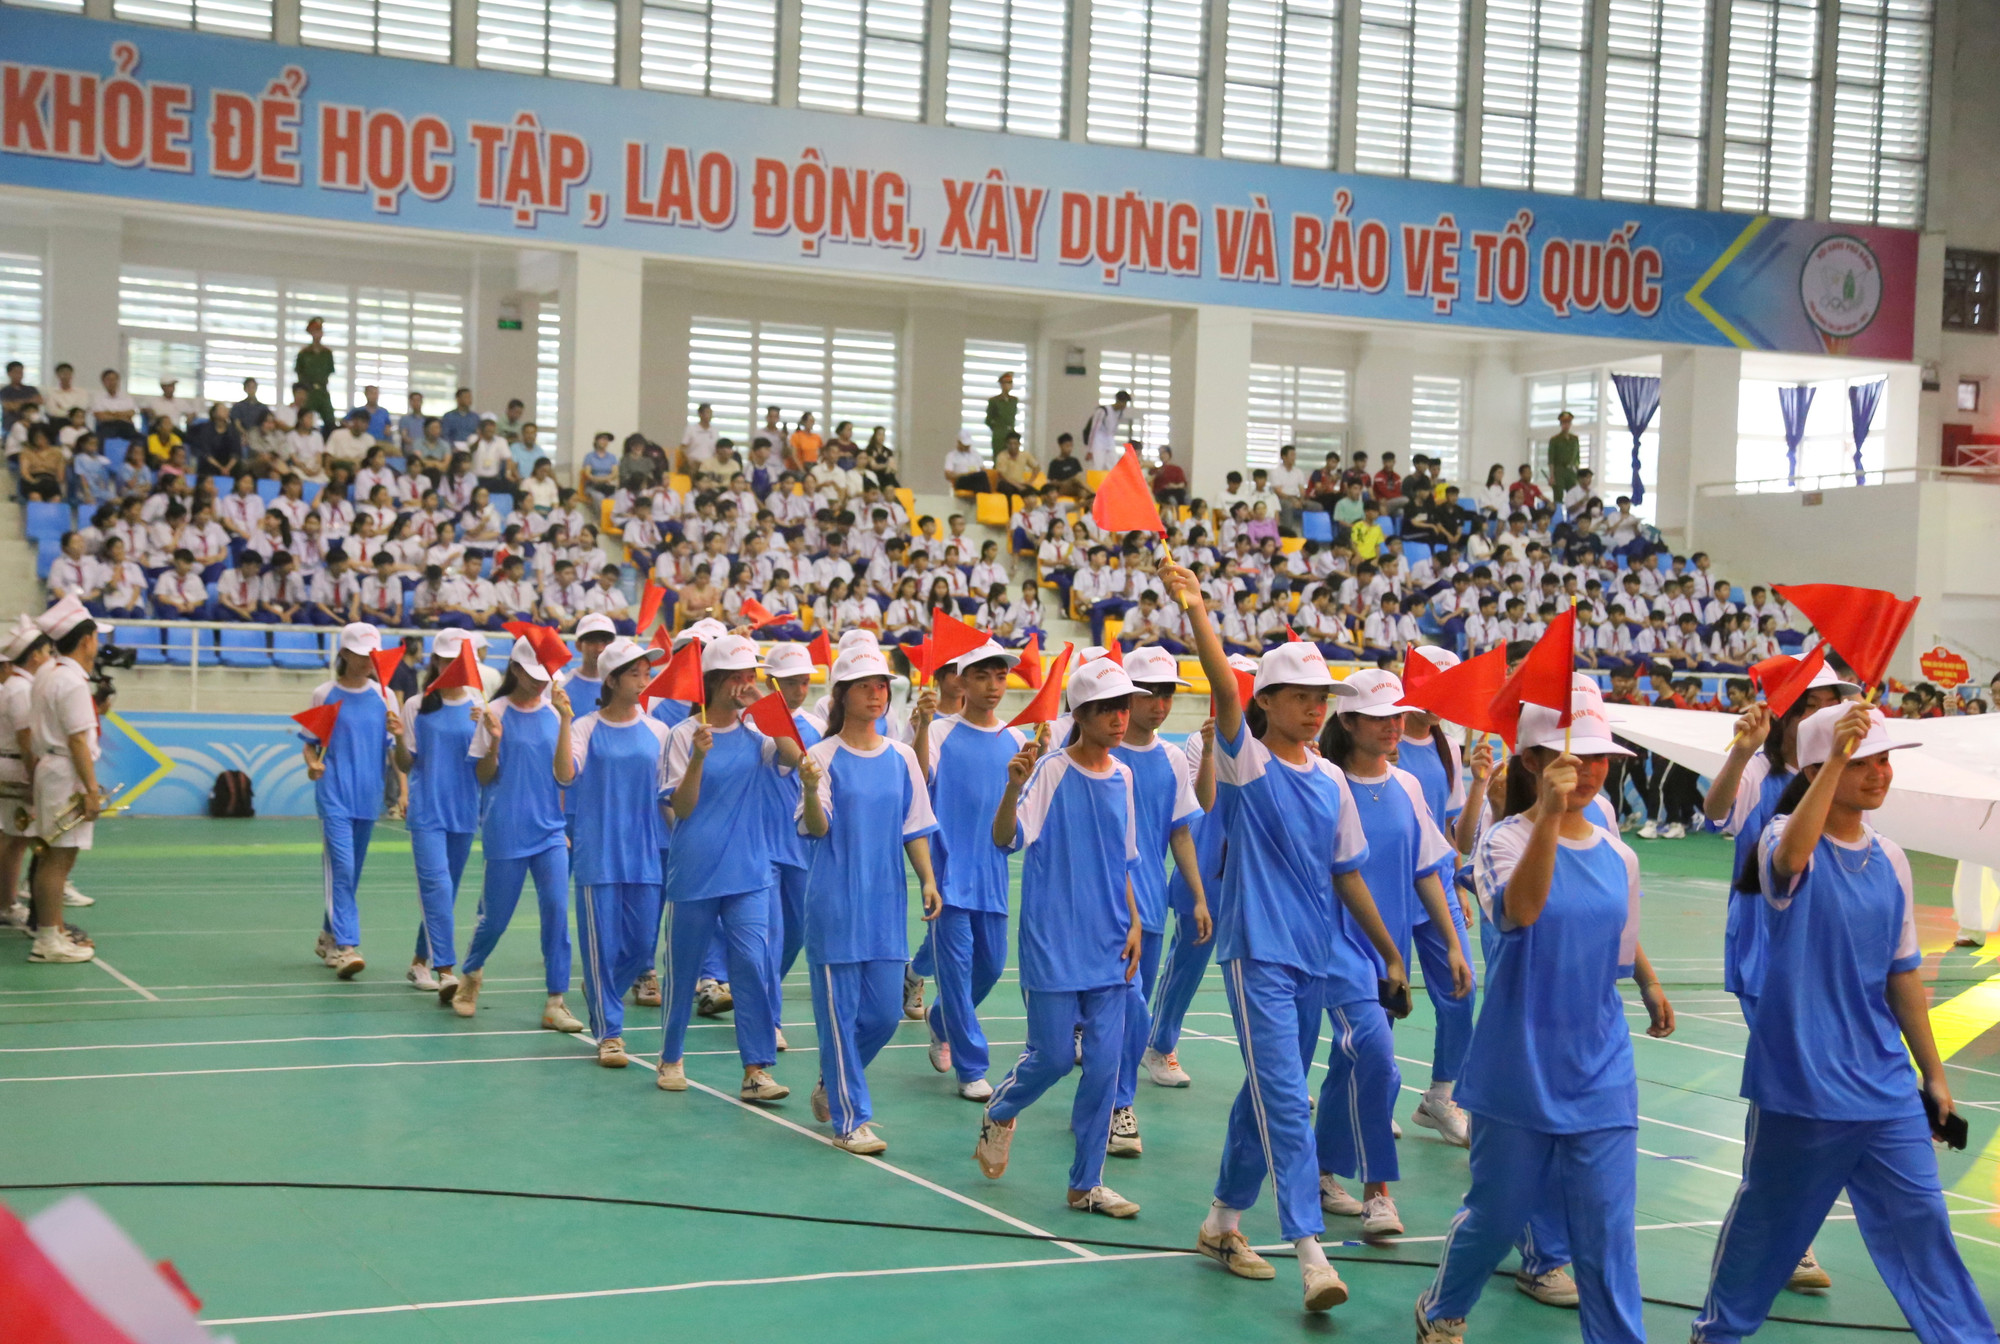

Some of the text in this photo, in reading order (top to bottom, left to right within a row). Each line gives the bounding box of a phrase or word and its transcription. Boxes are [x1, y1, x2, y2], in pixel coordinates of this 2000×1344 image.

[3, 44, 1662, 315] KHỎE ĐỂ HỌC TẬP, LAO ĐỘNG, XÂY DỰNG VÀ BẢO VỆ TỔ QUỐC
